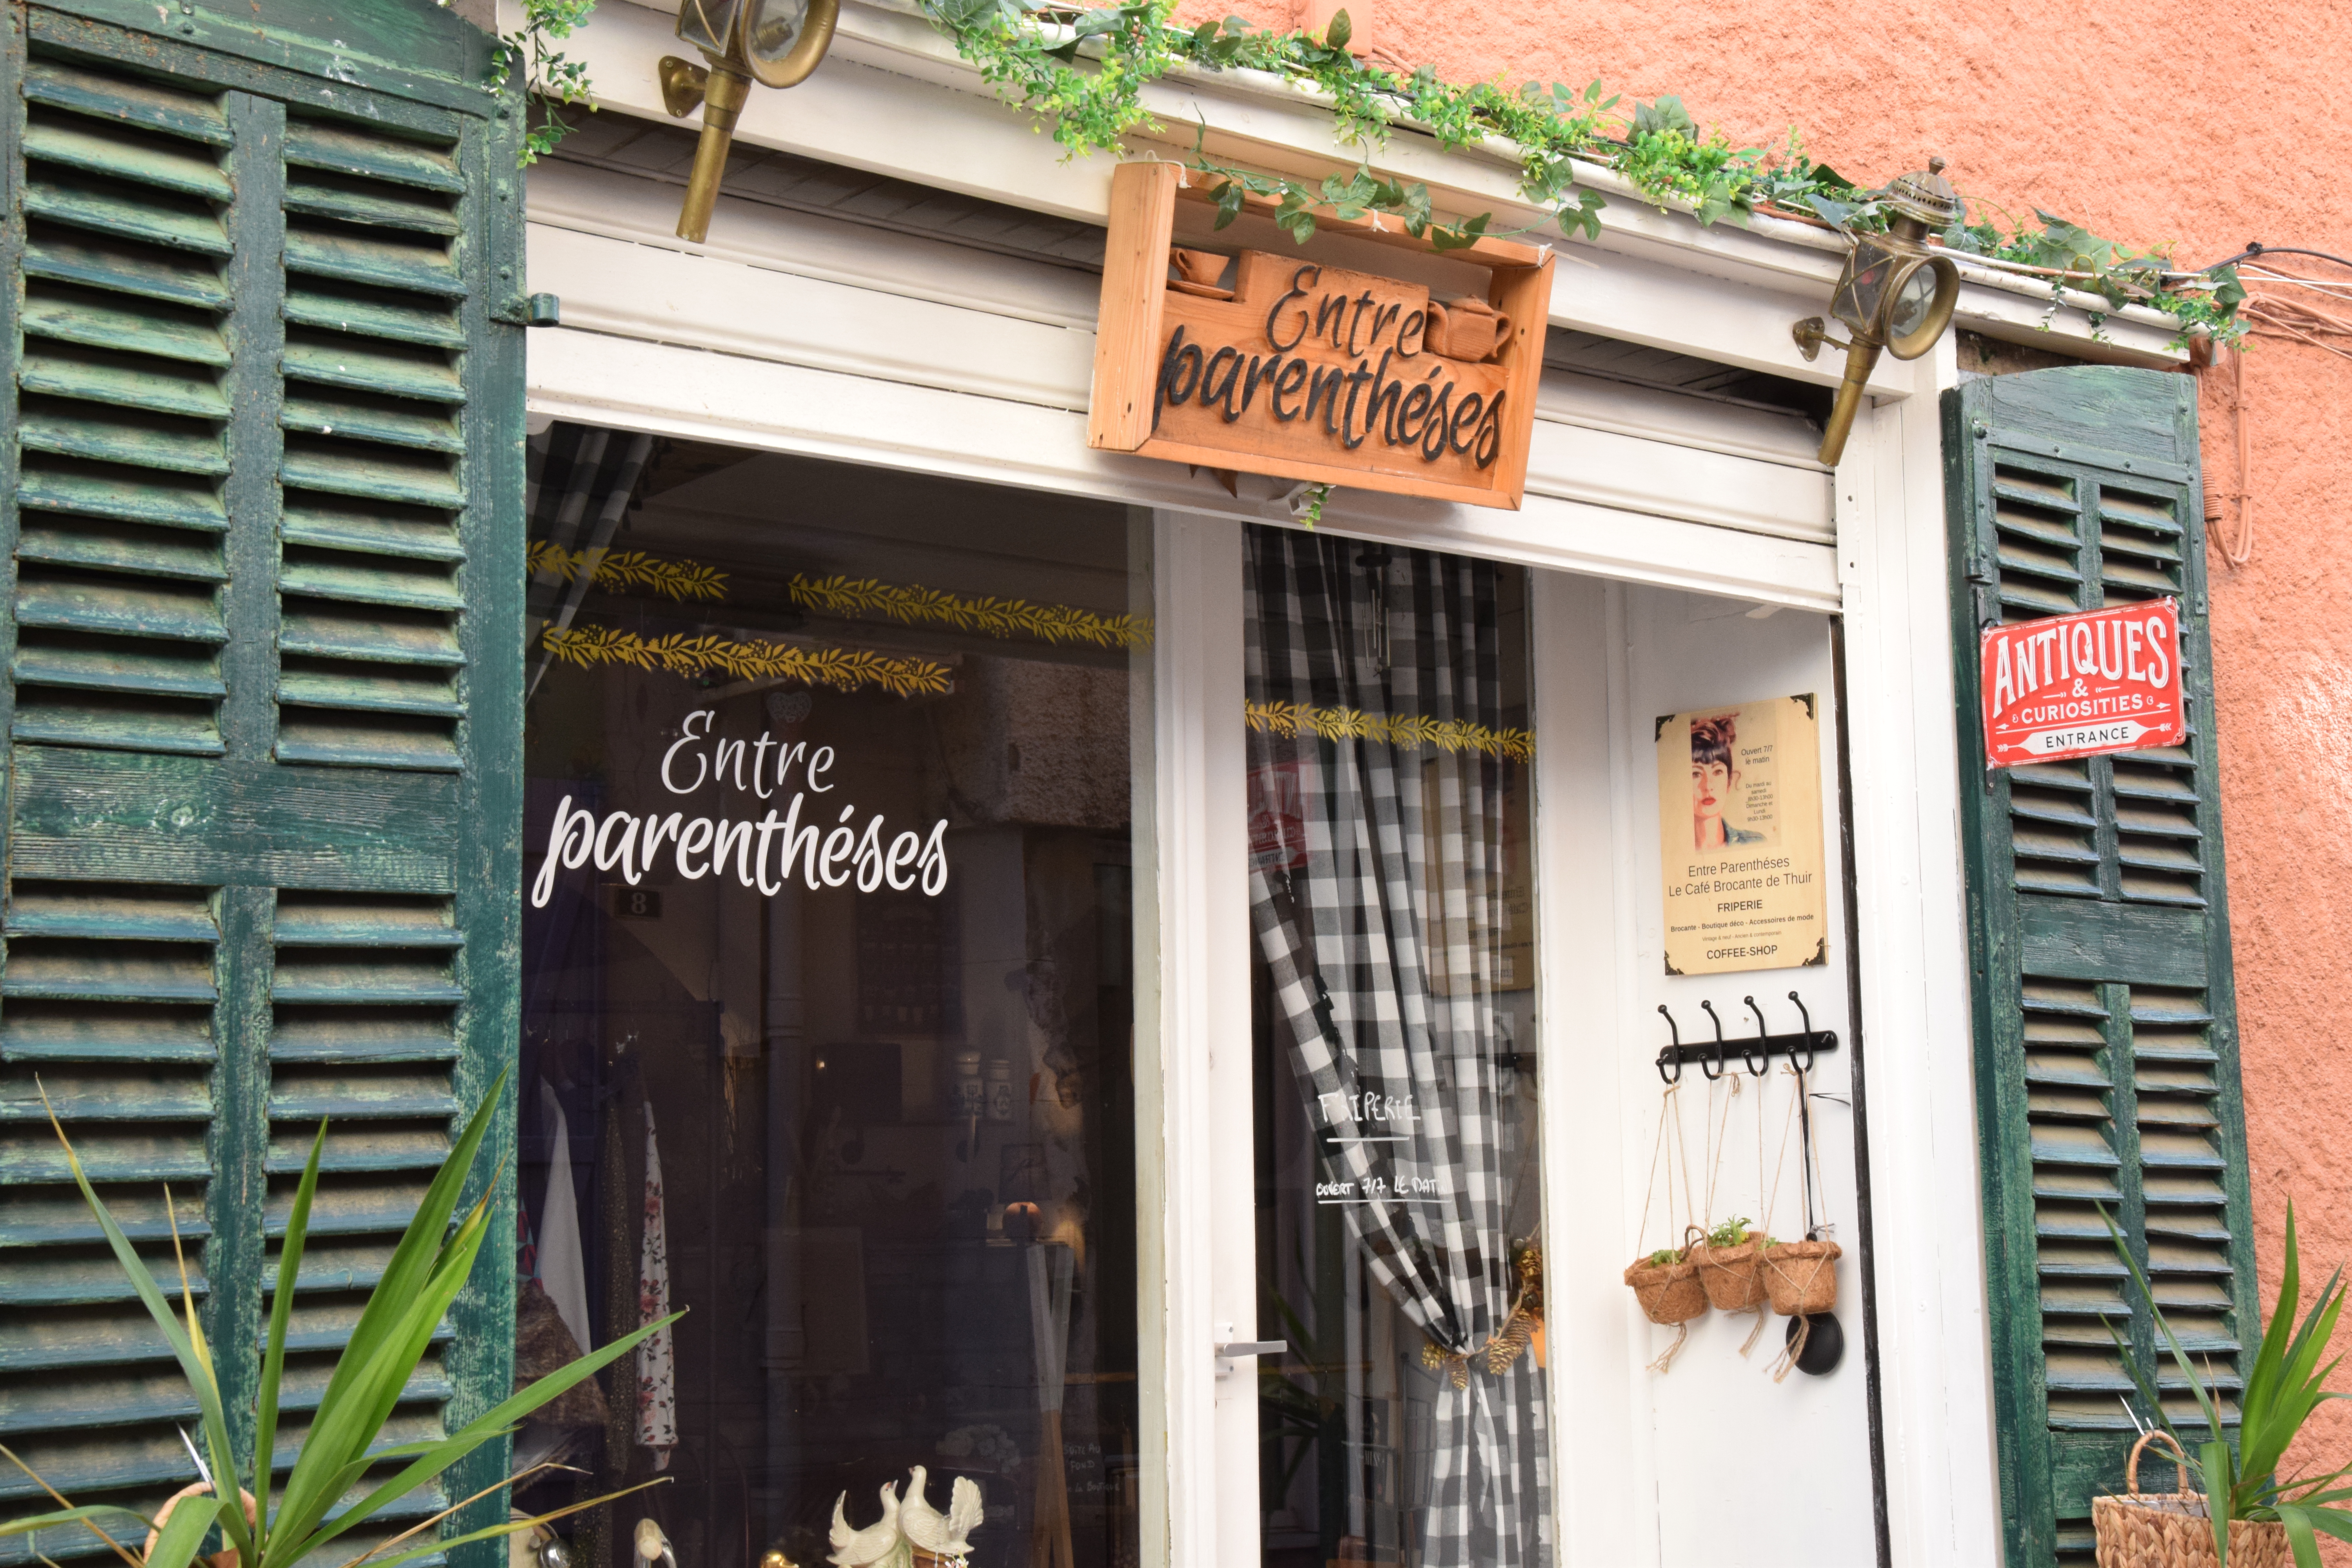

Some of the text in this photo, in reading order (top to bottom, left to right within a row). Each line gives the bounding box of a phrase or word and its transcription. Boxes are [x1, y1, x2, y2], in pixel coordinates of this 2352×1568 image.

[1267, 265, 1426, 357] Entre
[1152, 324, 1506, 470] parenthéses
[1993, 616, 2169, 719] ANTIQUES
[2072, 679, 2089, 697] &
[2022, 693, 2143, 724] CURIOSITIES
[2046, 727, 2129, 748] ENTRANCE
[661, 710, 835, 799] Entre
[1741, 747, 1762, 755] Ouvert
[1753, 756, 1769, 764] matin
[532, 792, 948, 908] parenthéses
[1689, 857, 1790, 877] Entre Parenthéses
[1669, 871, 1812, 897] Le Café Brocante de Thuir
[1718, 900, 1763, 913] FRIPERIE
[1749, 917, 1786, 925] Accessoires
[1707, 945, 1778, 959] COFFEE-SHOP
[1316, 1180, 1354, 1198] OUVERT
[1362, 1176, 1386, 1194] 7/7
[1394, 1175, 1409, 1194] LE
